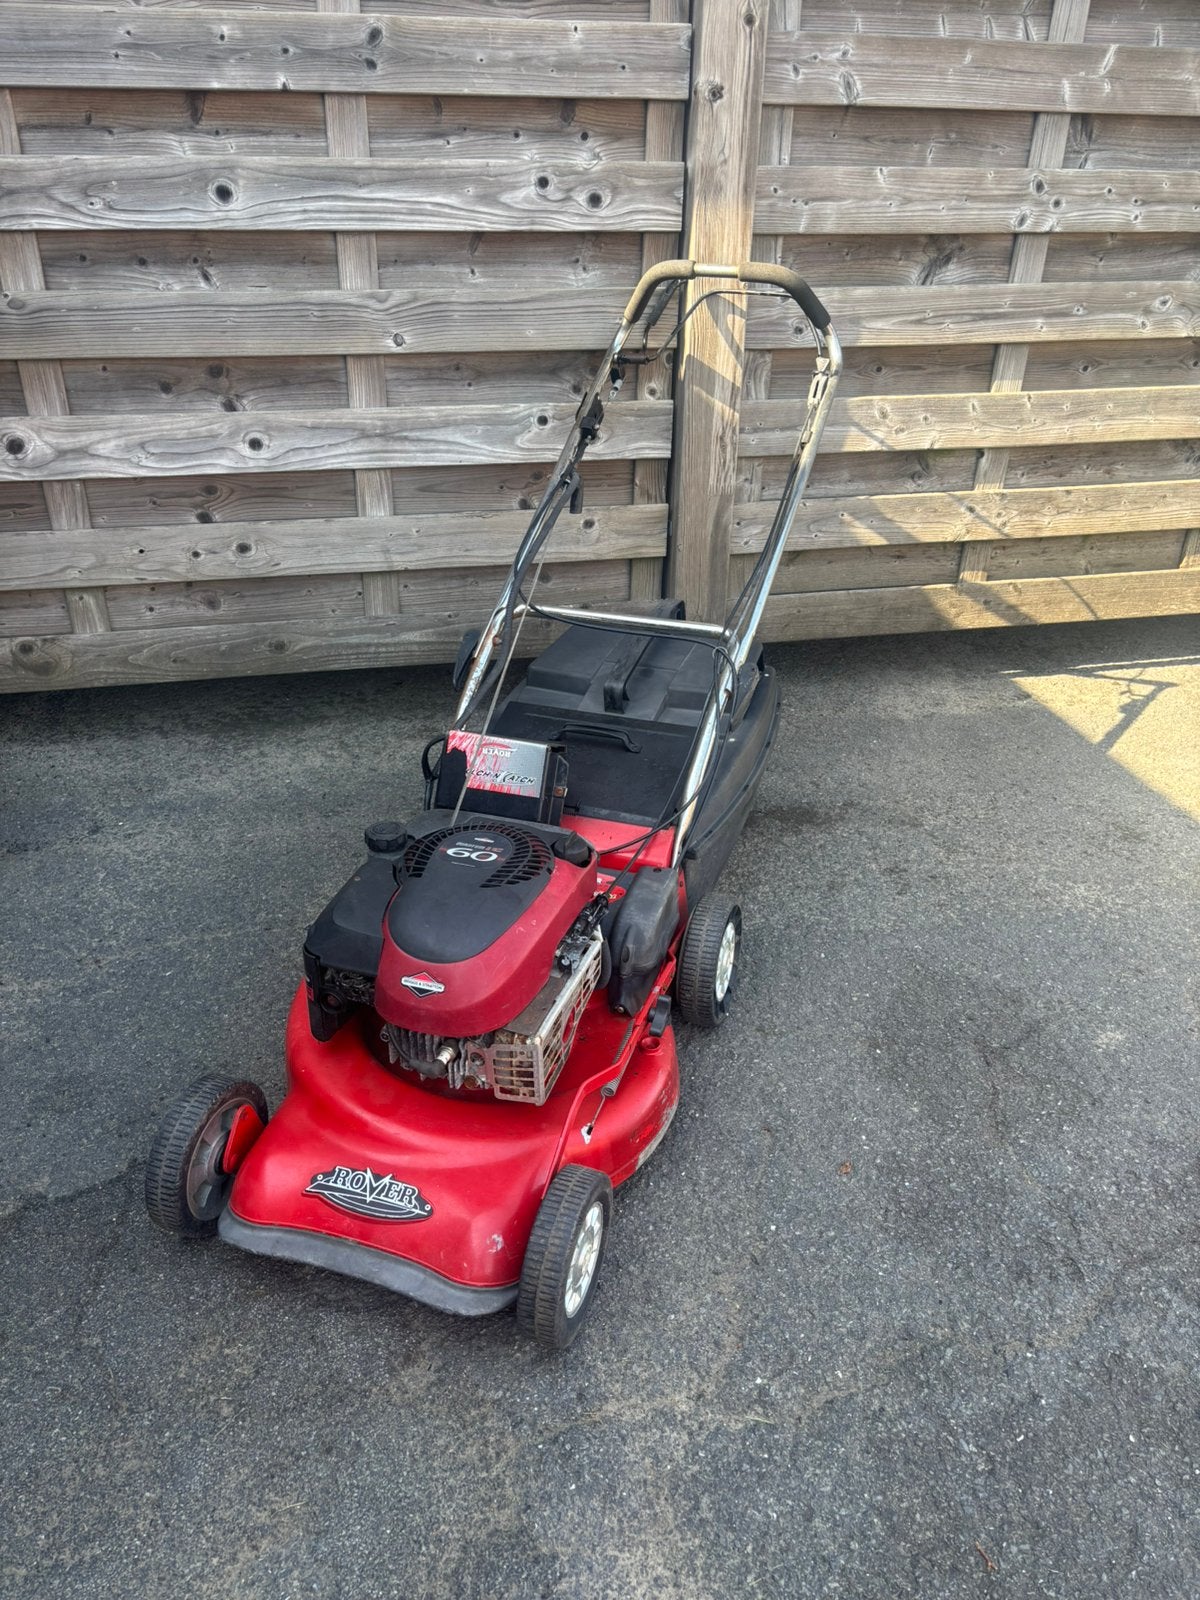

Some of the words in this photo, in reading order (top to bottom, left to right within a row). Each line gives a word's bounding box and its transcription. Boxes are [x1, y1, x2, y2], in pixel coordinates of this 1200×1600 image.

[482, 747, 511, 758] ROVER
[446, 847, 498, 862] 60
[331, 1165, 419, 1208] ROVER
